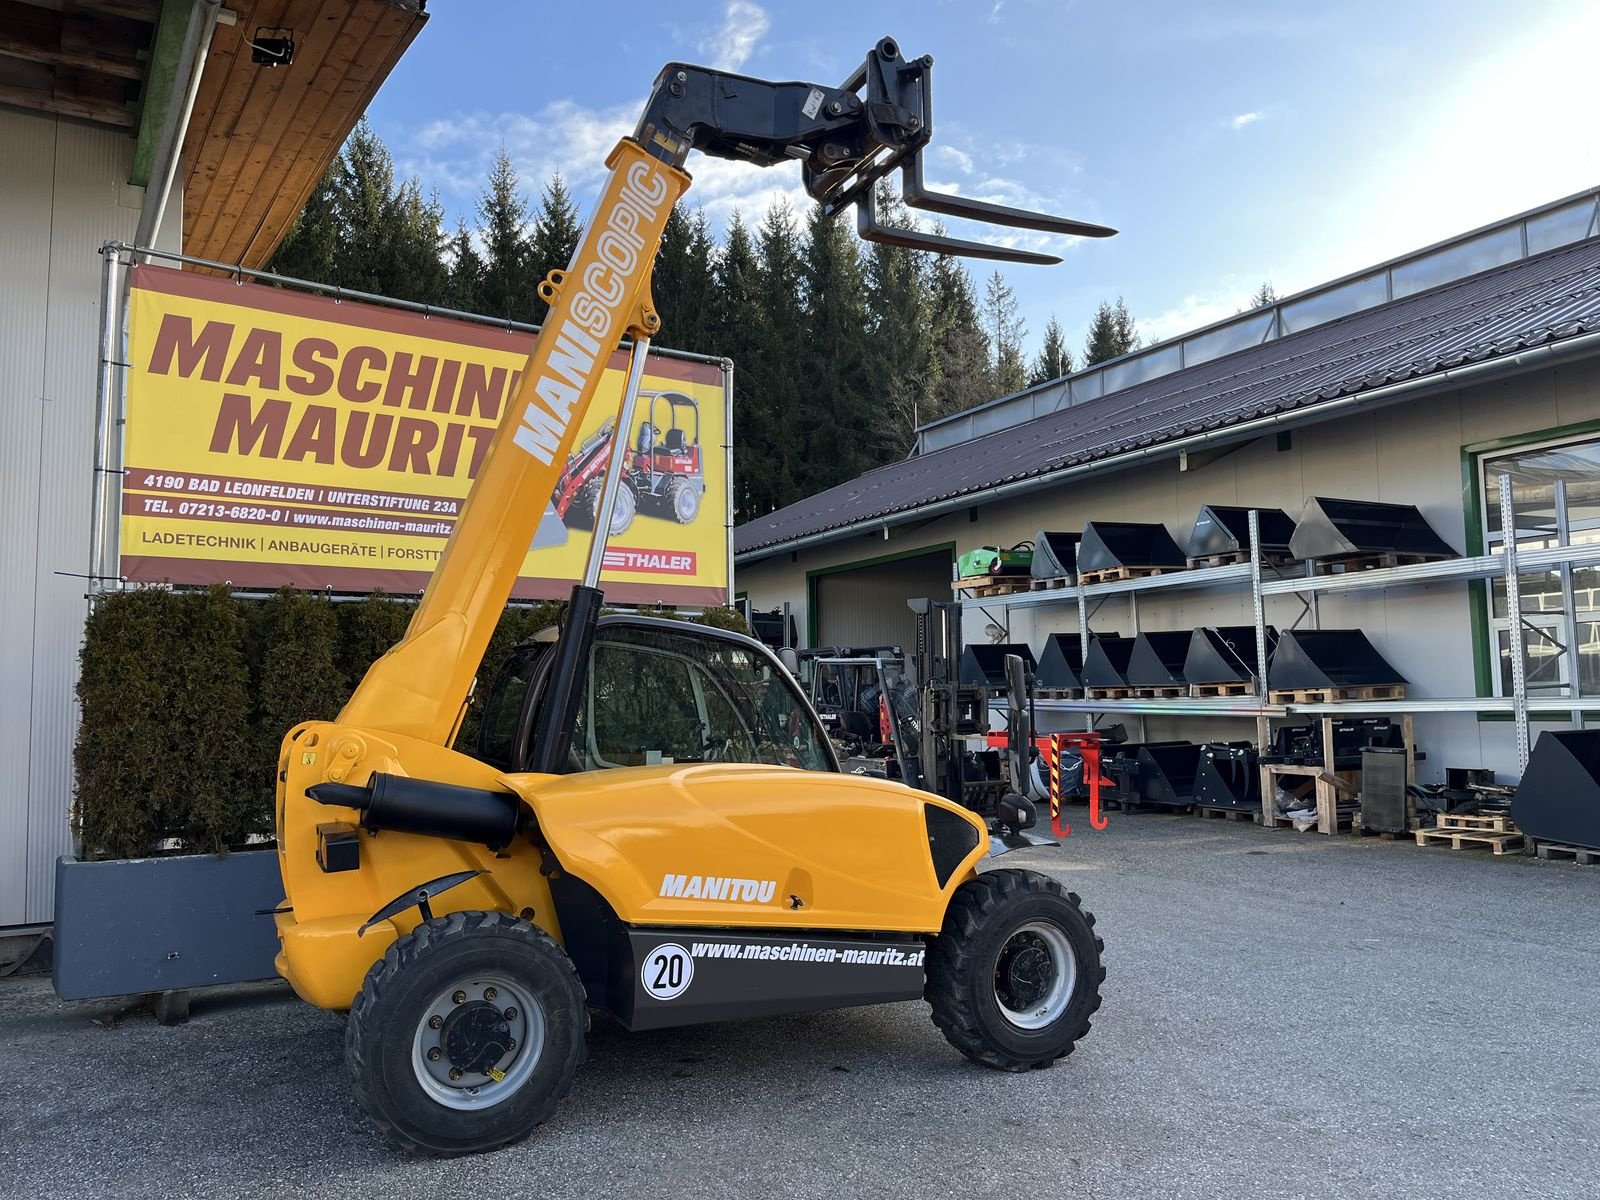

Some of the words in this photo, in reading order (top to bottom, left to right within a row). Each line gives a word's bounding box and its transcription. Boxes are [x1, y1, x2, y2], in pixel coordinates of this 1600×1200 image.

[513, 160, 668, 468] MANISCOPIC
[143, 475, 185, 490] 4190
[188, 478, 220, 493] BAD
[223, 481, 315, 501] LEONFELDEN
[327, 491, 430, 511] UNTERSTIFTUNG
[432, 500, 457, 513] 23A
[144, 499, 174, 514] TEL.
[178, 502, 281, 521] 07213-6820-0
[142, 531, 256, 550] LADETECHNIK
[268, 540, 377, 557] ANBAUGERÄTE
[387, 547, 443, 561] FORSTT
[626, 553, 692, 570] THALER
[659, 873, 776, 903] MANITOU
[652, 954, 684, 989] 20
[691, 943, 925, 967] www.maschinen-mauritz.at
